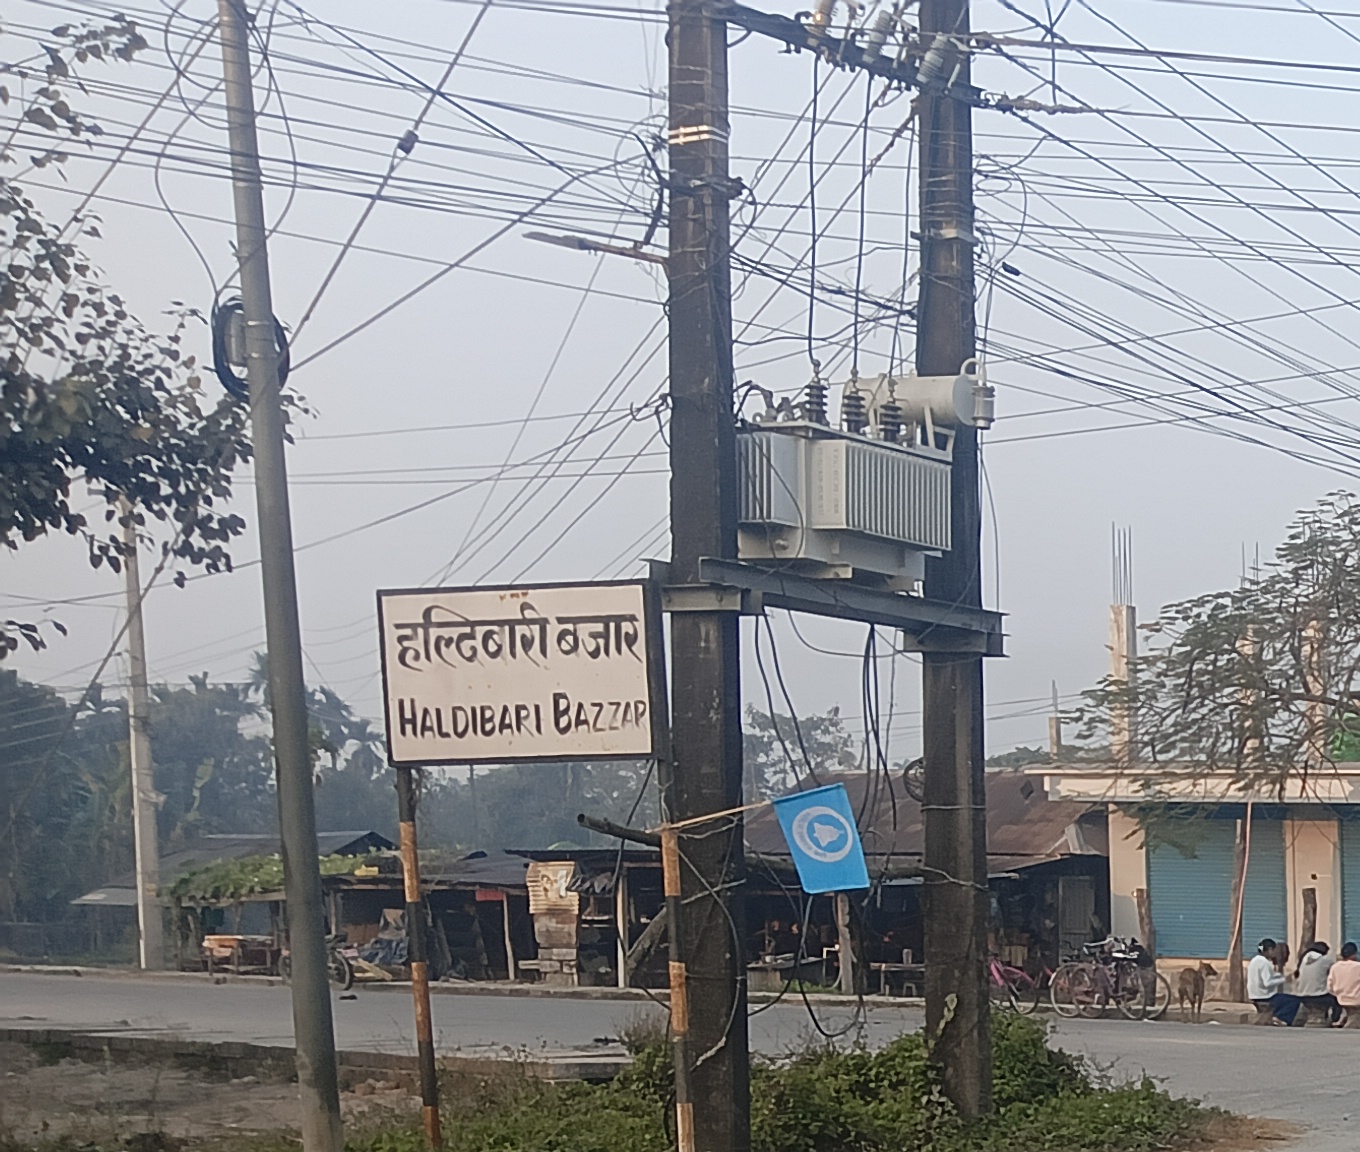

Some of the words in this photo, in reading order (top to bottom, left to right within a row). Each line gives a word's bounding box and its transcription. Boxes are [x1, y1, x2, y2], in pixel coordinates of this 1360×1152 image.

[394, 602, 551, 672] हल्दिबारी
[555, 613, 643, 664] बजार
[398, 697, 543, 738] HALDIBARI
[552, 692, 648, 735] BAZZAR
